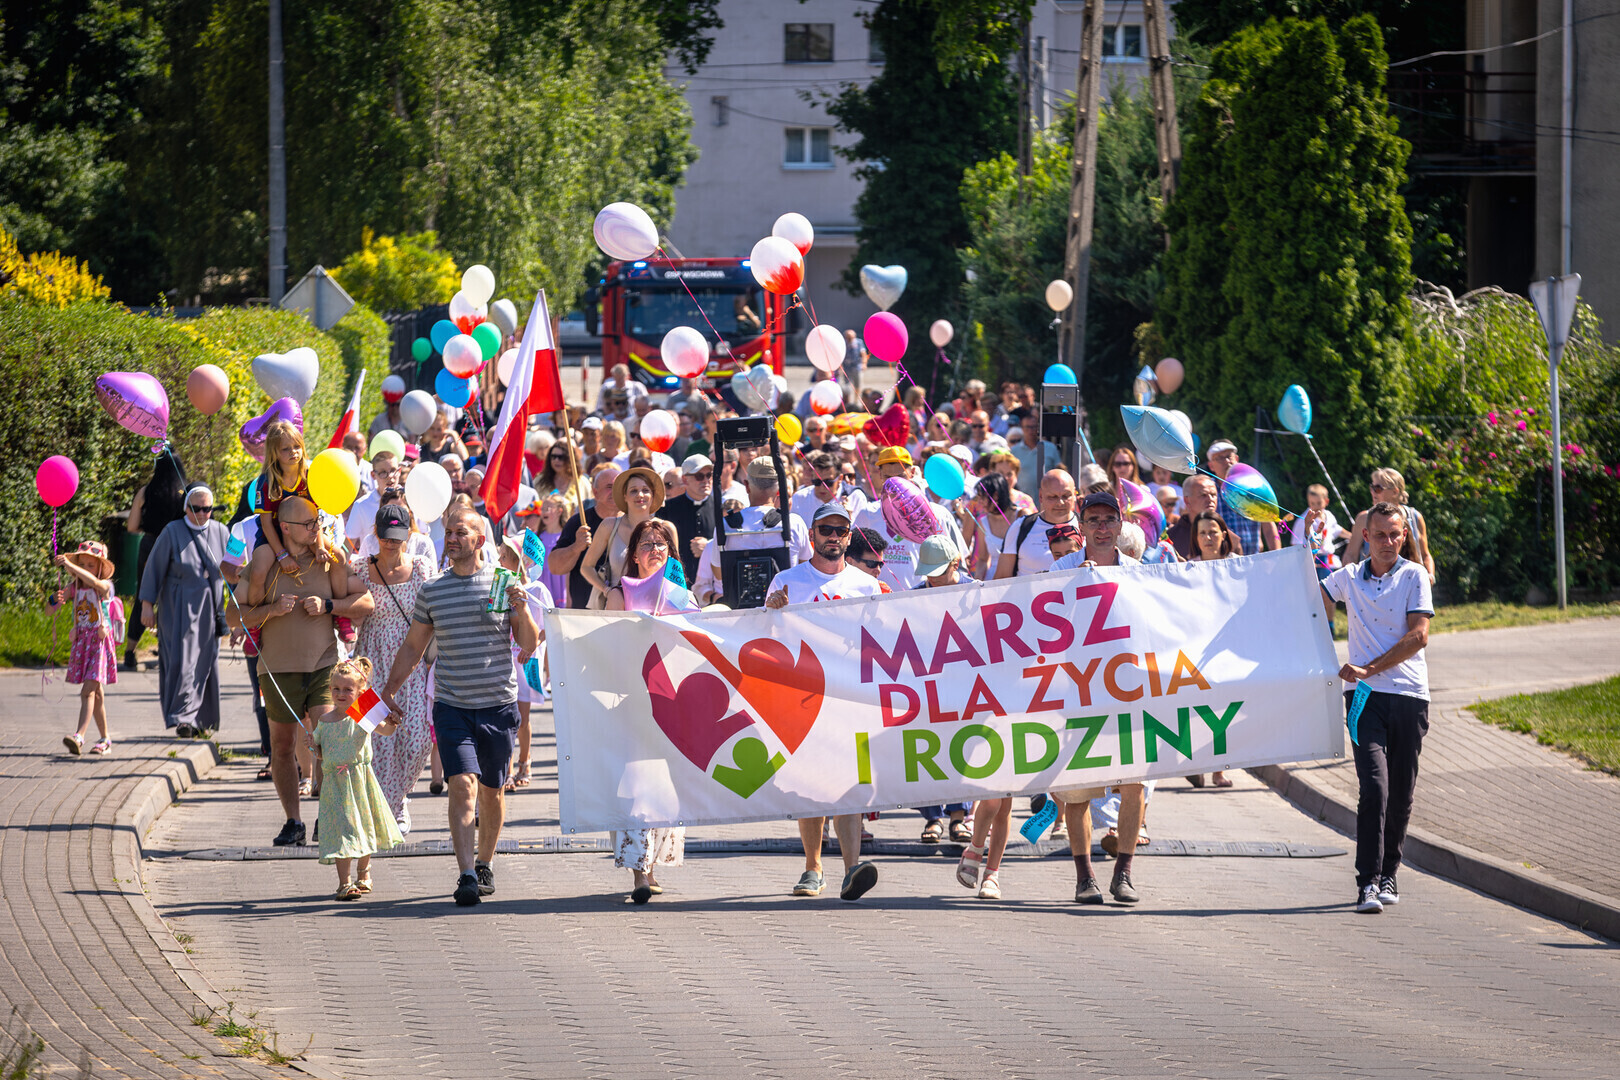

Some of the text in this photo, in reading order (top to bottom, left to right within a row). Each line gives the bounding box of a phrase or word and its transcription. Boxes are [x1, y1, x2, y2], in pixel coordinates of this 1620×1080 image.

[860, 582, 1131, 684] MARSZ
[878, 649, 1212, 728] DLA ŻYCIA
[855, 701, 1244, 784] I RODZINY
